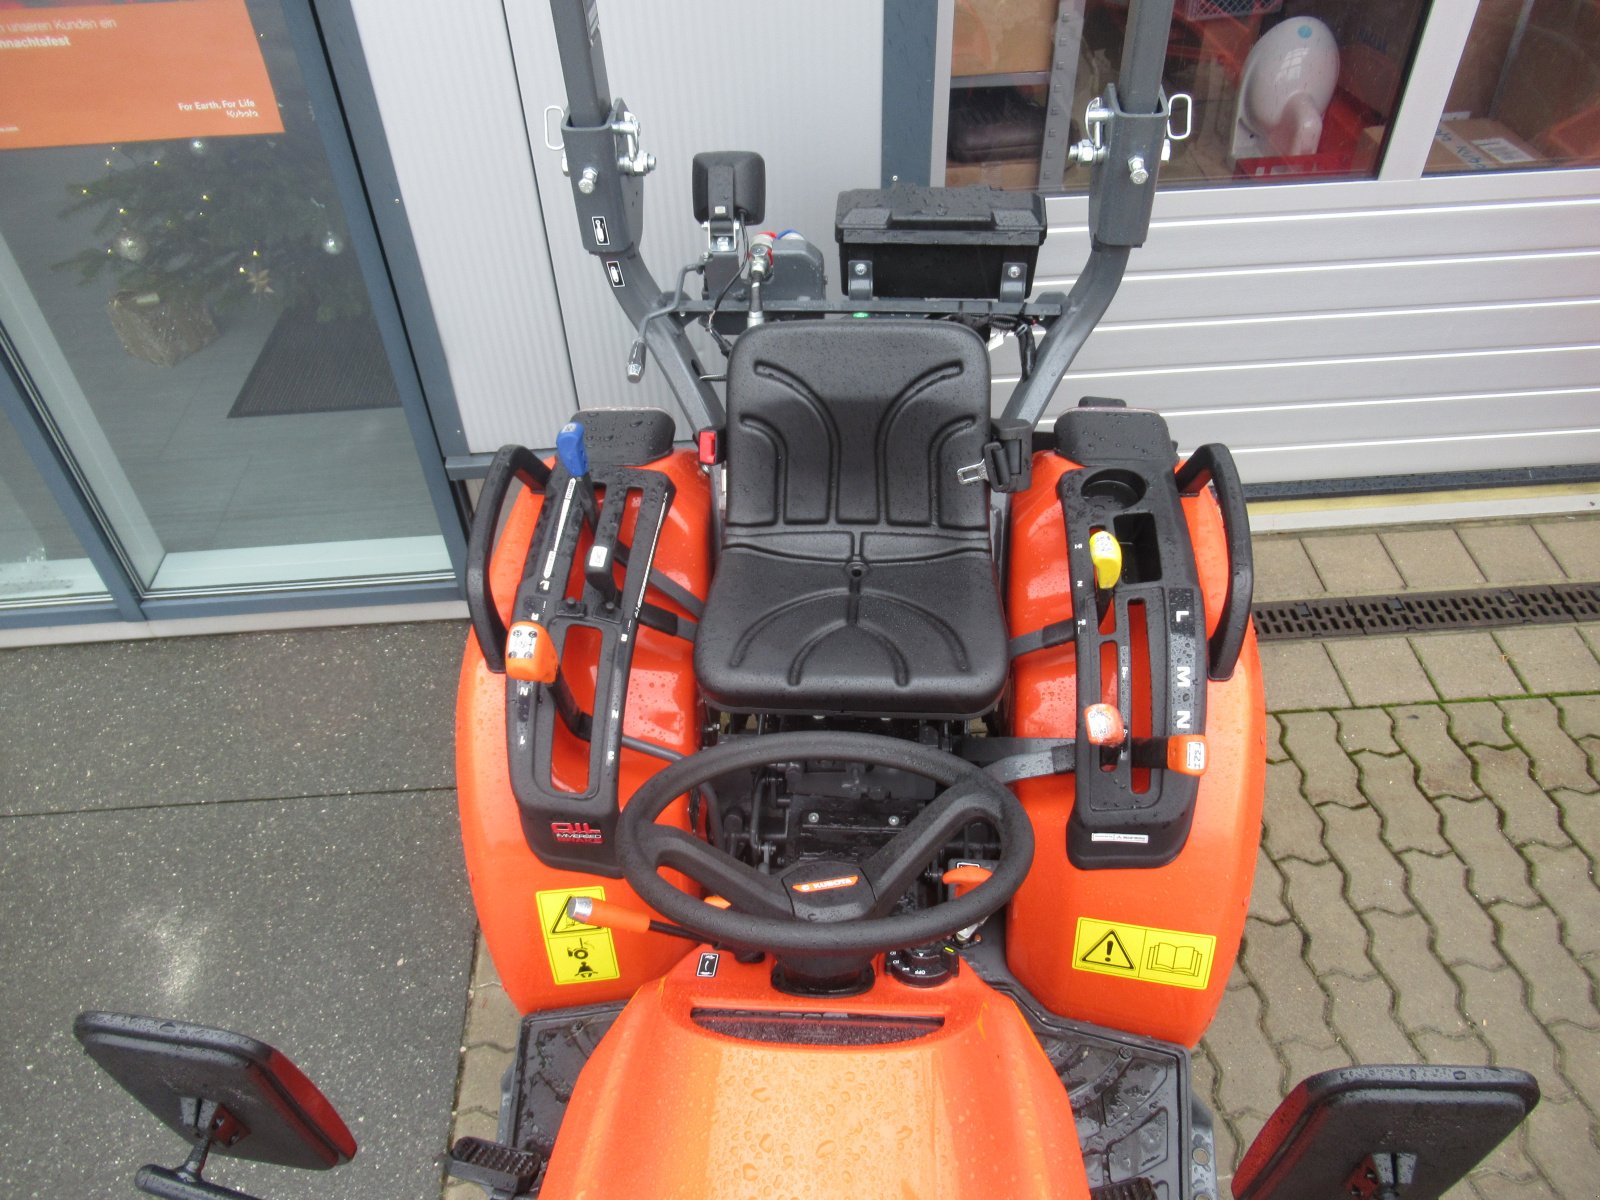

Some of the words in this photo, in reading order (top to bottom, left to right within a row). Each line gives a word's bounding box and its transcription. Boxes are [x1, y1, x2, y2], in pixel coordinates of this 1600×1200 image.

[54, 18, 98, 30] Kunden
[99, 18, 118, 29] ein
[178, 102, 193, 111] For
[222, 99, 236, 108] For
[238, 98, 256, 108] Life
[1175, 610, 1190, 623] L
[1176, 666, 1191, 688] M
[551, 822, 601, 834] OIL
